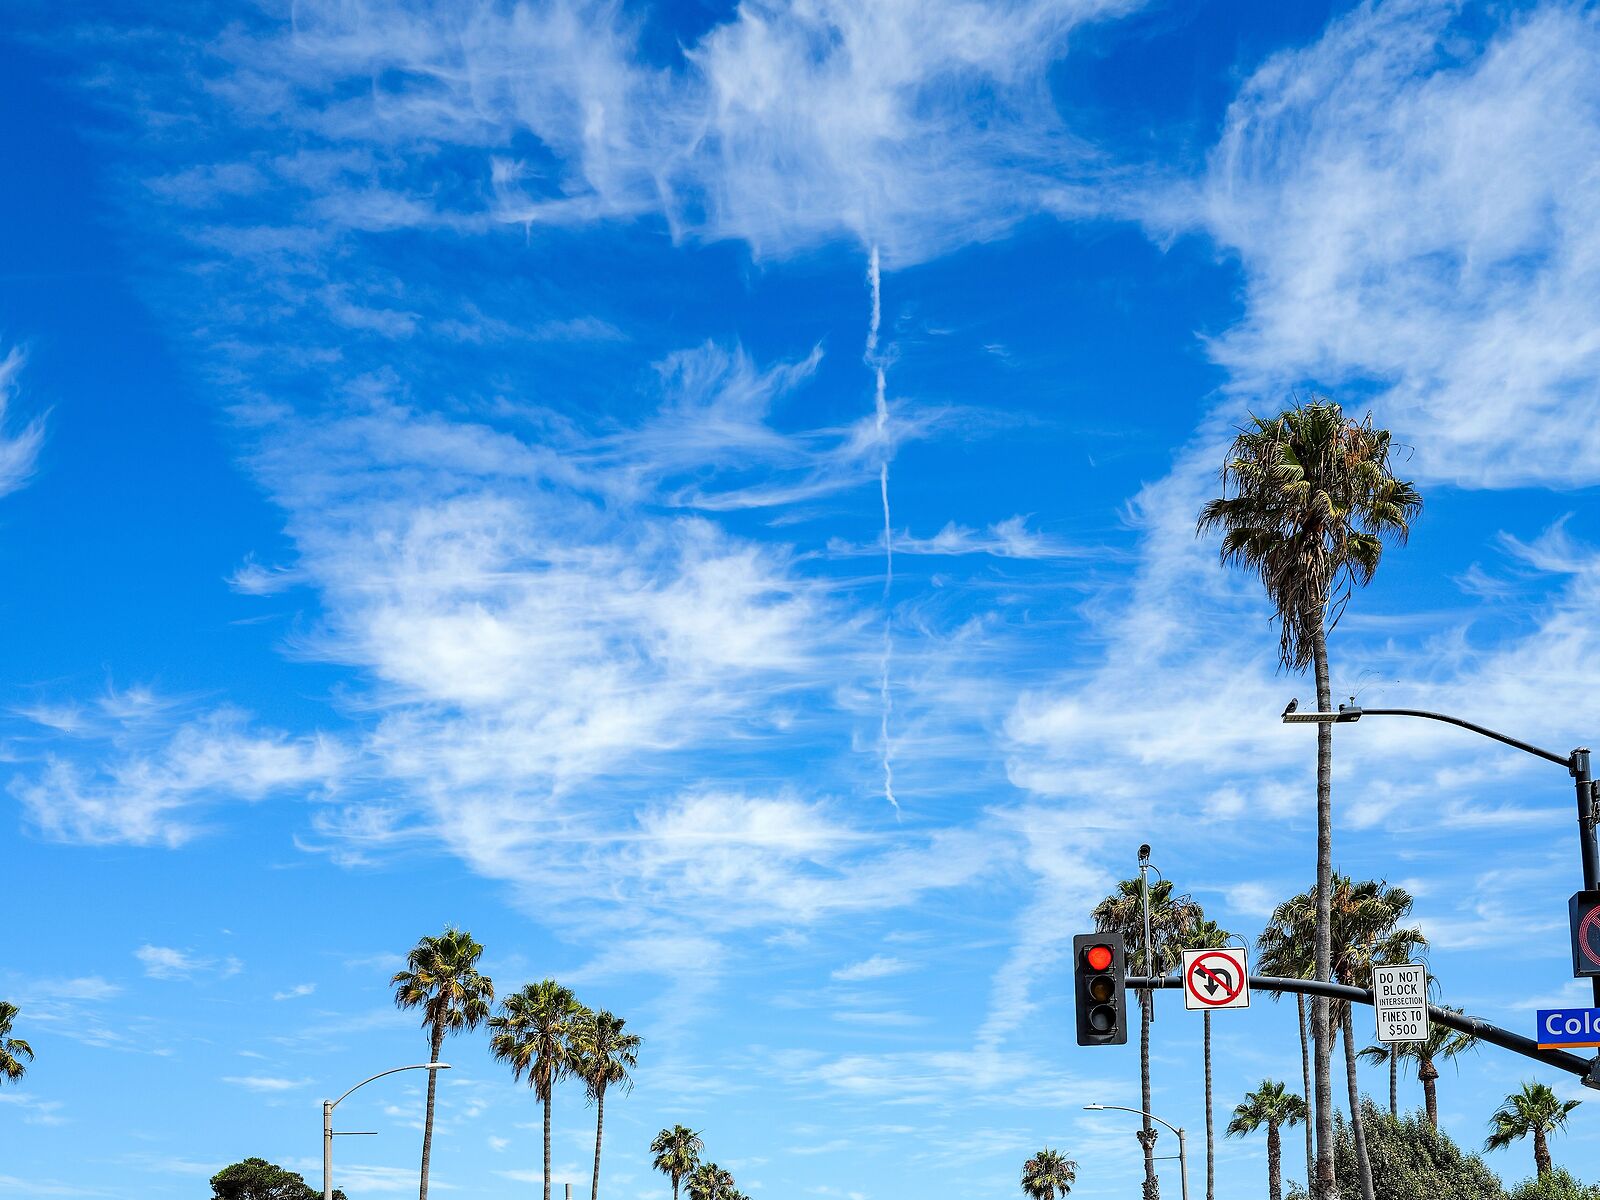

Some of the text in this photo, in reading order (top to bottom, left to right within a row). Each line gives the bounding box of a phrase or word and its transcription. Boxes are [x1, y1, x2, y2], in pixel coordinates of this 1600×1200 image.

[1379, 972, 1419, 984] DO NOT
[1383, 984, 1418, 996] BLOCK
[1379, 997, 1423, 1006] INTERSECTION
[1382, 1010, 1422, 1022] FINES TO
[1389, 1024, 1417, 1036] $500
